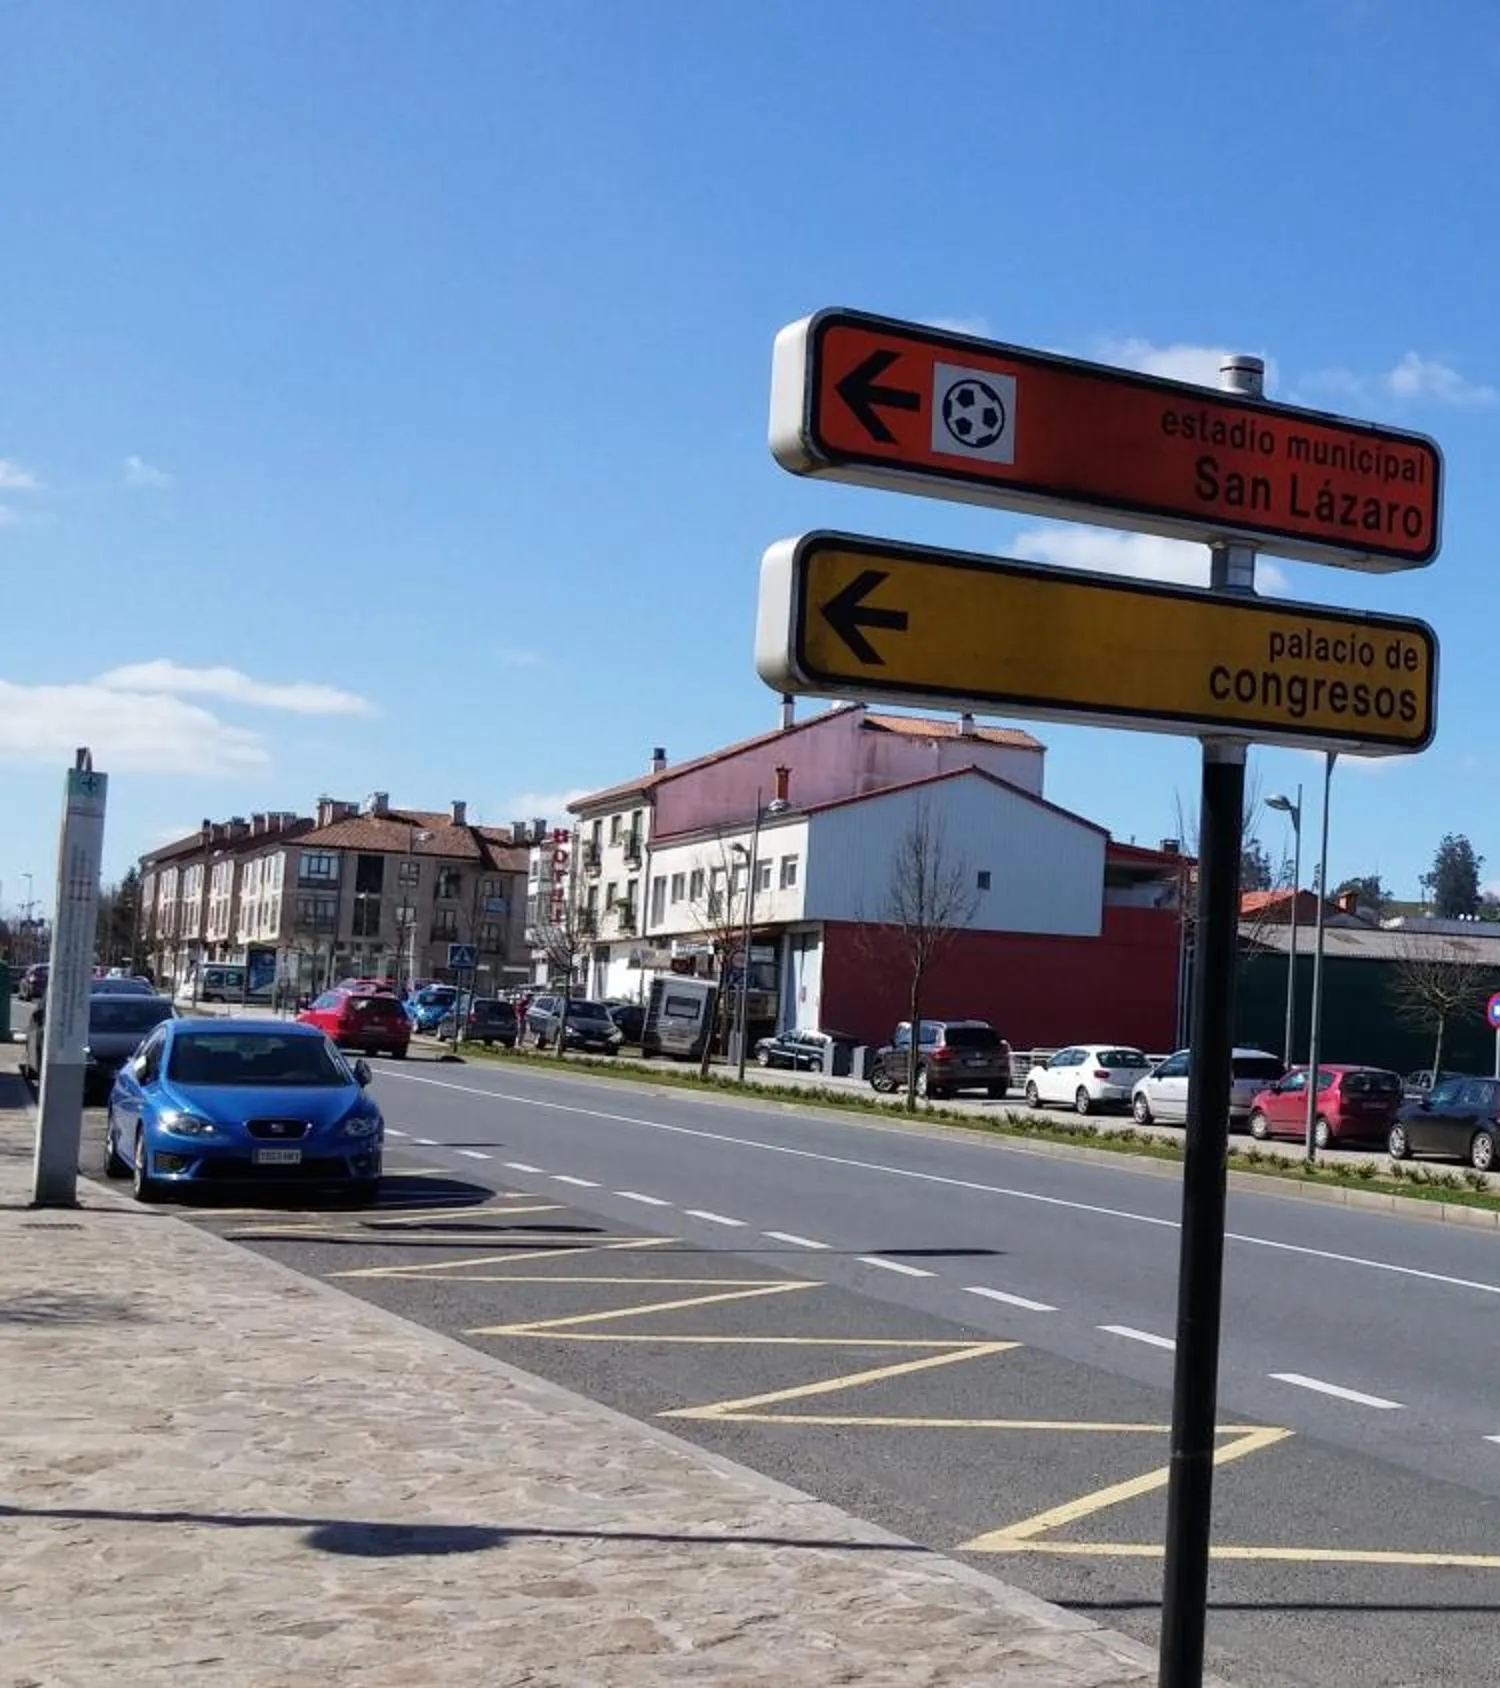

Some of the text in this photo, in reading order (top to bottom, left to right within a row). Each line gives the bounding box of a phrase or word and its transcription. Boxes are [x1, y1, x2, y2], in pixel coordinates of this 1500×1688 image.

[1160, 409, 1425, 485] estadio municipal
[1194, 454, 1423, 538] San Lázaro
[1269, 627, 1418, 672] palacio de
[1209, 664, 1417, 722] congresos
